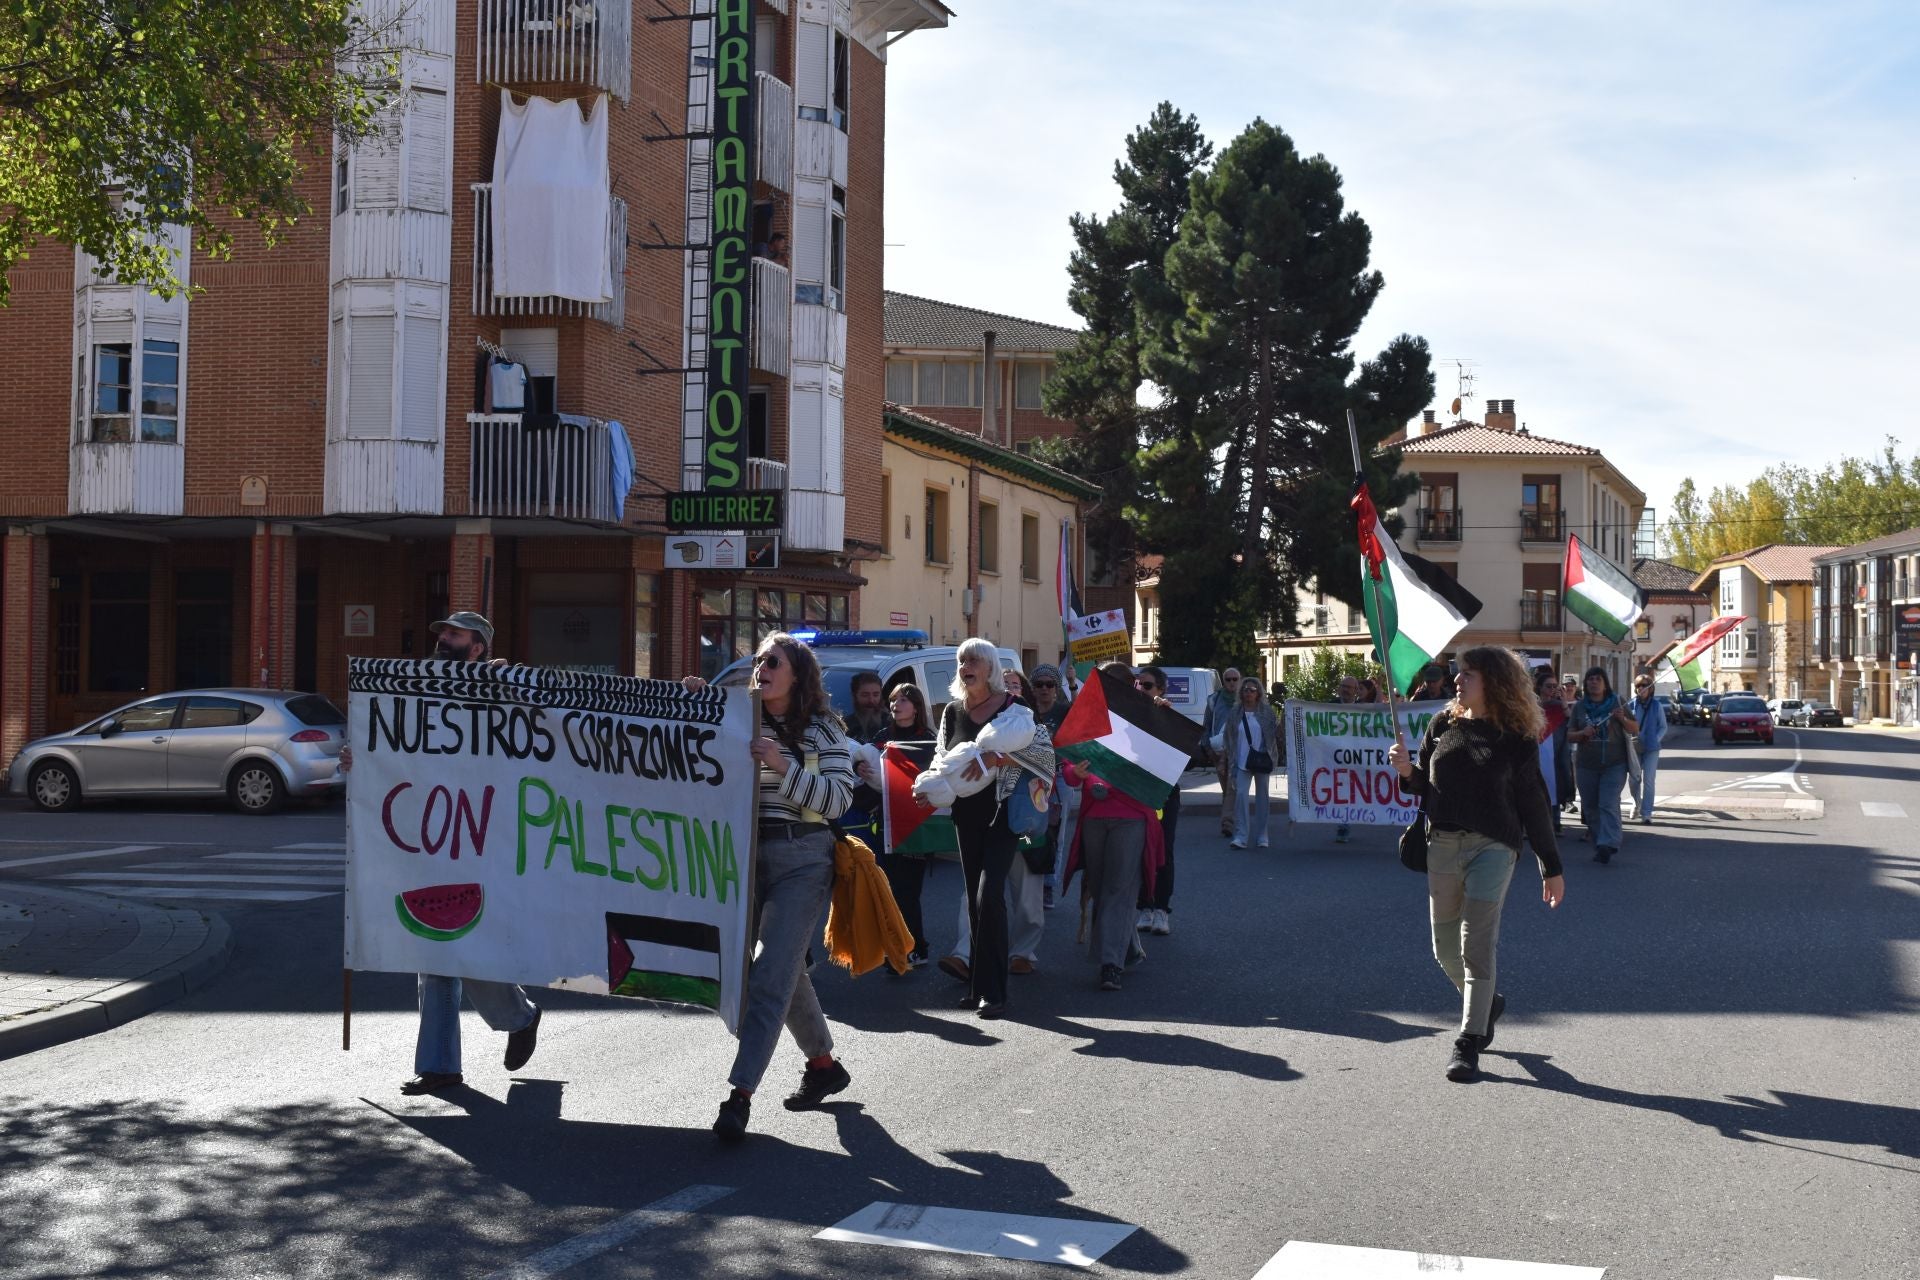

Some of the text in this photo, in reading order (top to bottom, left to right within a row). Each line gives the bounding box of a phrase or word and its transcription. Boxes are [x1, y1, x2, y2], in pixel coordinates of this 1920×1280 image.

[671, 495, 775, 523] GUTIERREZ
[367, 697, 724, 786] NUESTROS CORAZONES
[1333, 749, 1391, 766] CONTR
[1311, 766, 1419, 808] GENOC
[381, 776, 739, 908] CON PALESTINA
